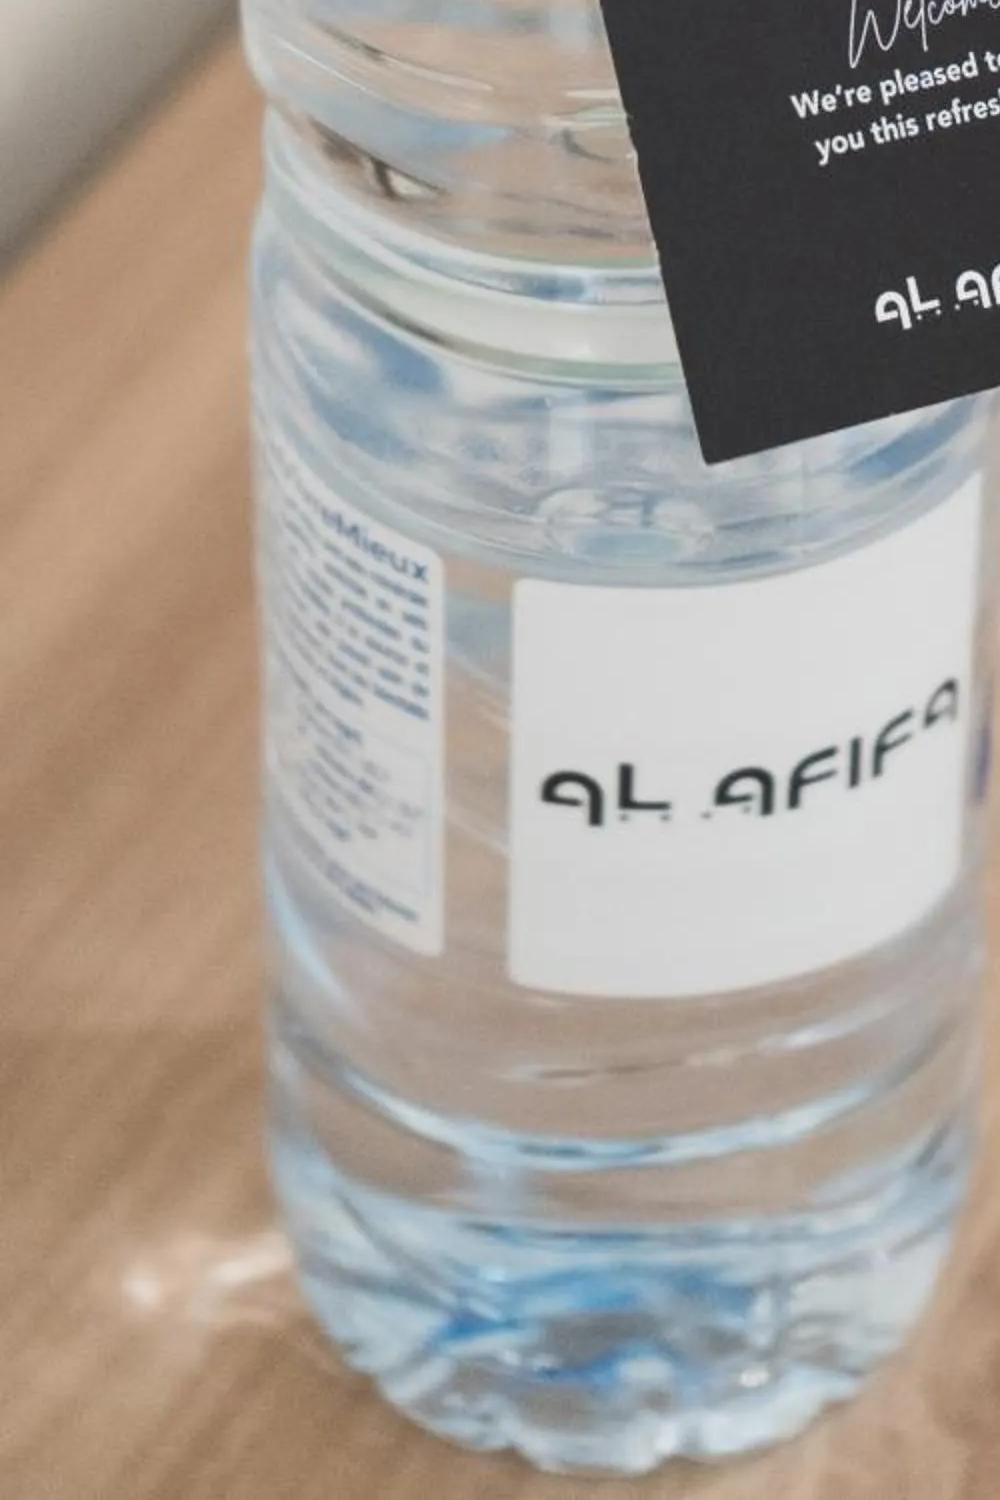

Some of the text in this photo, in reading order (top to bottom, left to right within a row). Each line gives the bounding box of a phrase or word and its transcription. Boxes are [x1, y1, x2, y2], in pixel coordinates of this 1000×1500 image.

[879, 51, 979, 106] pleased
[814, 130, 866, 167] you
[869, 113, 920, 145] this
[540, 762, 671, 827] AL
[701, 675, 961, 819] AFIFA
